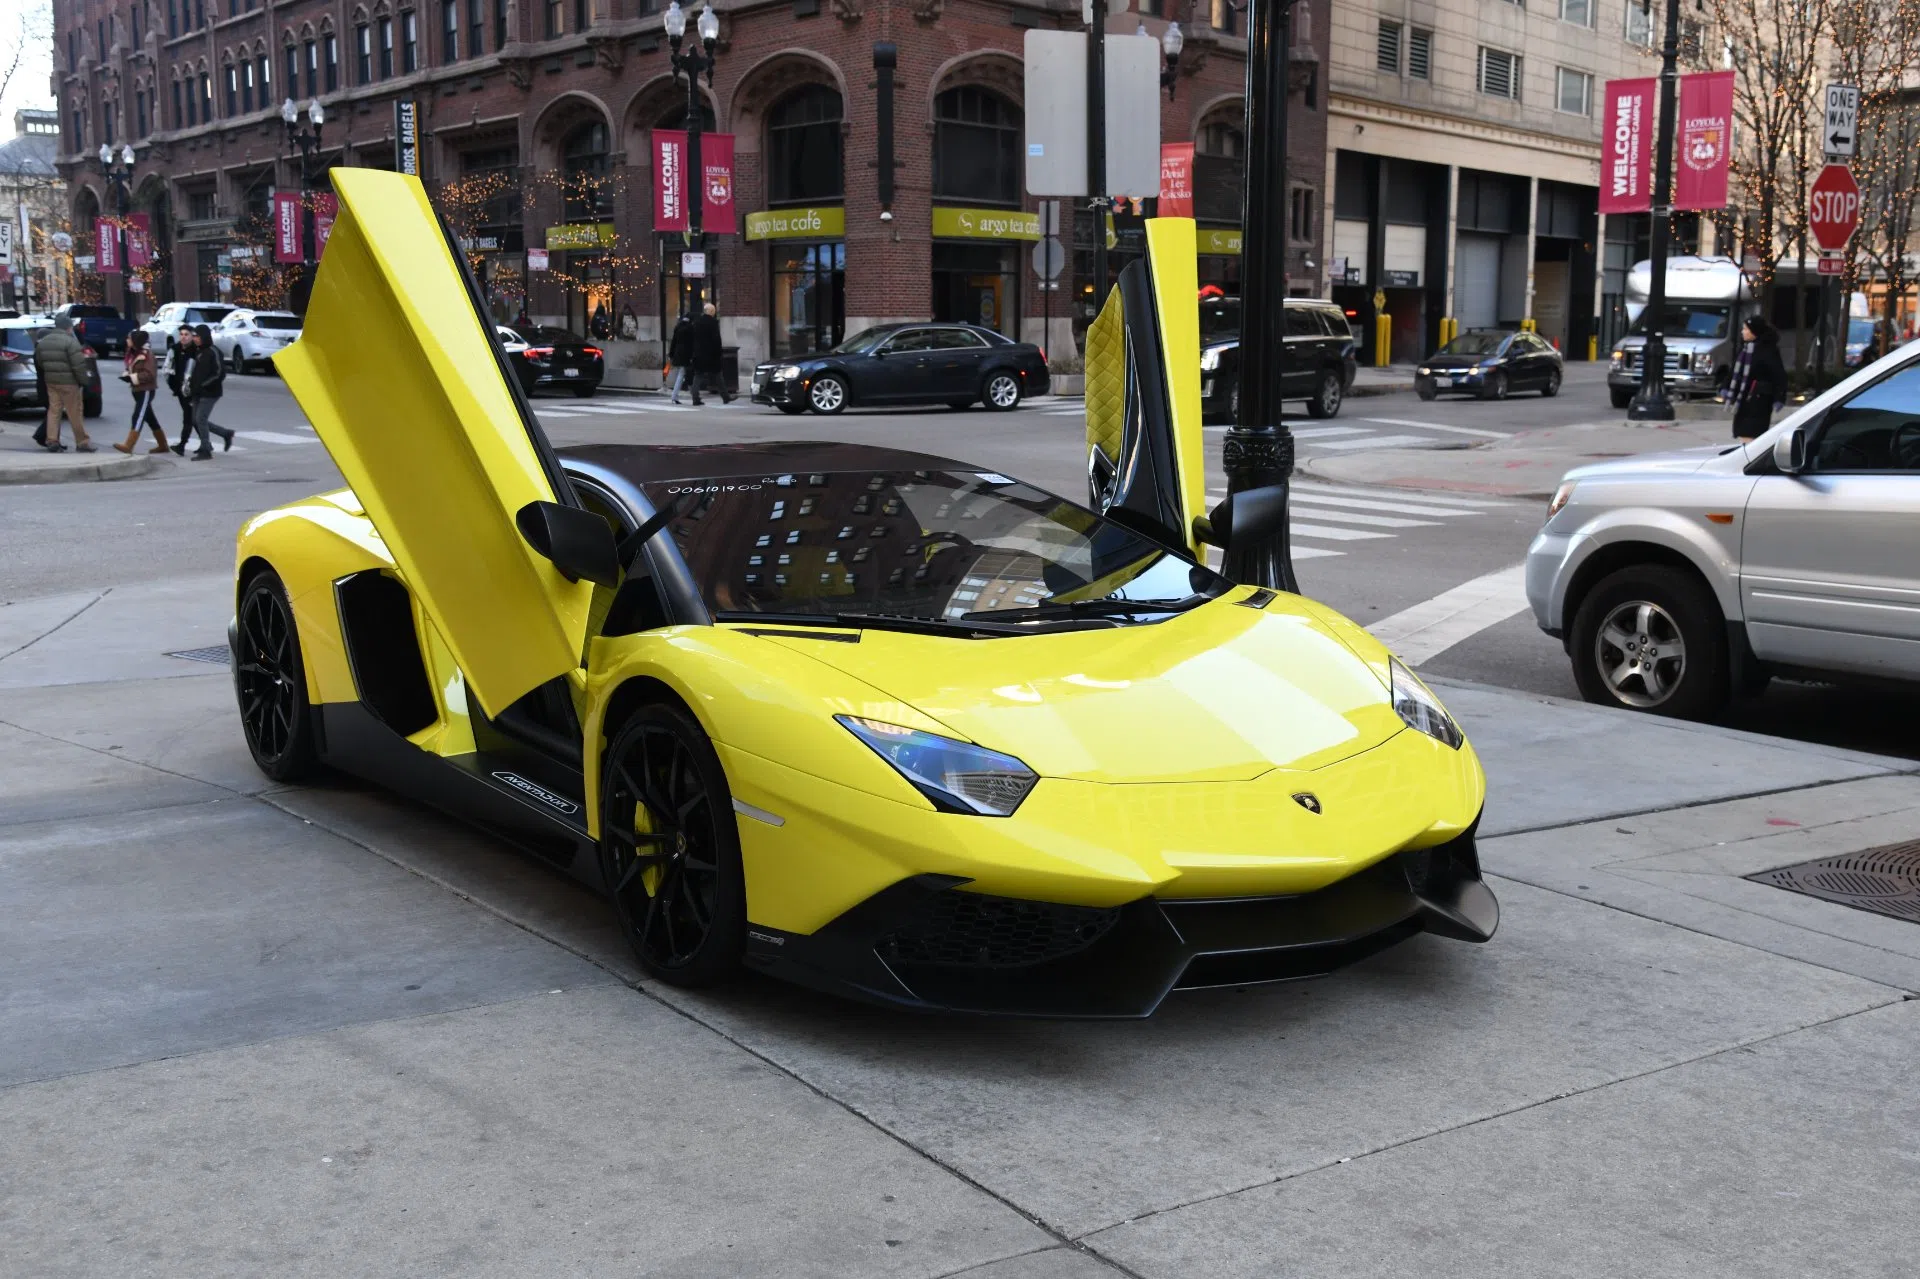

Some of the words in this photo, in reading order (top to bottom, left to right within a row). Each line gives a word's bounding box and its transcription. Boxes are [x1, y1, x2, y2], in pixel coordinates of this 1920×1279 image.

[1631, 95, 1642, 133] CAMPUS
[1830, 91, 1854, 109] ONE
[401, 103, 415, 144] BAGELS
[1685, 117, 1725, 129] LOYOLA
[1828, 110, 1853, 128] WAY
[1613, 95, 1632, 197] WELCOME
[1630, 134, 1640, 165] TOWER
[662, 142, 674, 218] WELCOME
[706, 166, 730, 174] LOYOLA
[1161, 168, 1185, 179] David
[1170, 179, 1185, 189] Lee
[1629, 166, 1638, 196] WATER
[773, 218, 788, 232] tea
[791, 209, 821, 230] café
[1812, 191, 1856, 224] STOP
[281, 201, 291, 254] WELCOME
[980, 219, 1008, 236] argo
[1009, 219, 1024, 233] tea
[100, 224, 109, 267] WELCOME
[503, 776, 569, 808] AVENTADOR
